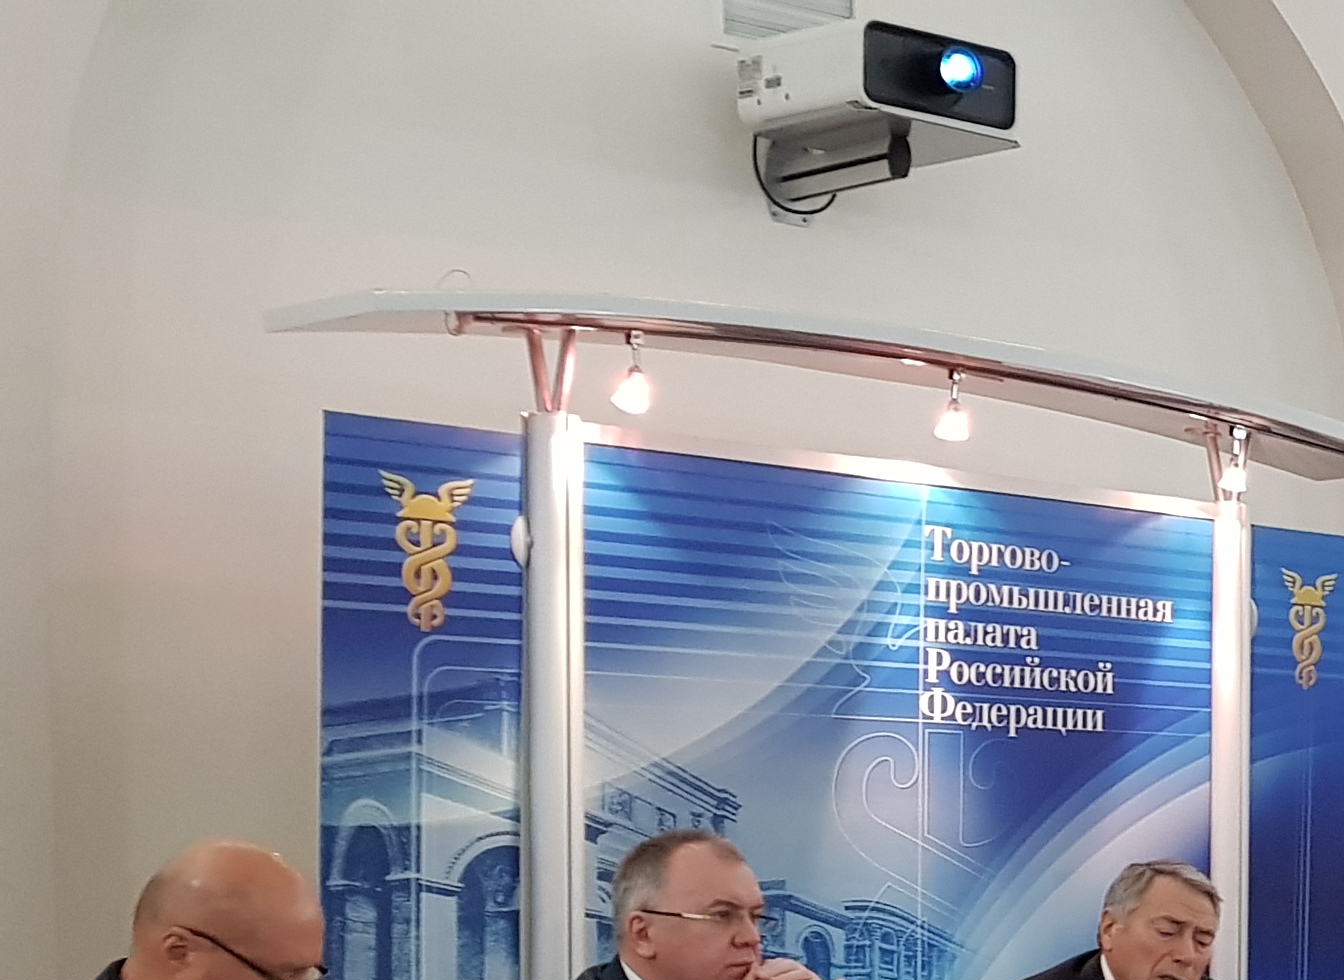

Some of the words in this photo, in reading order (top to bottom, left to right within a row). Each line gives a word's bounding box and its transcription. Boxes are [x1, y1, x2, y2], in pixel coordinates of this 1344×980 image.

[924, 525, 1071, 575] Торгово-
[926, 577, 1174, 623] промышленная
[925, 617, 1038, 650] палата
[925, 647, 1115, 694] Российской
[919, 687, 1105, 737] Федерации
